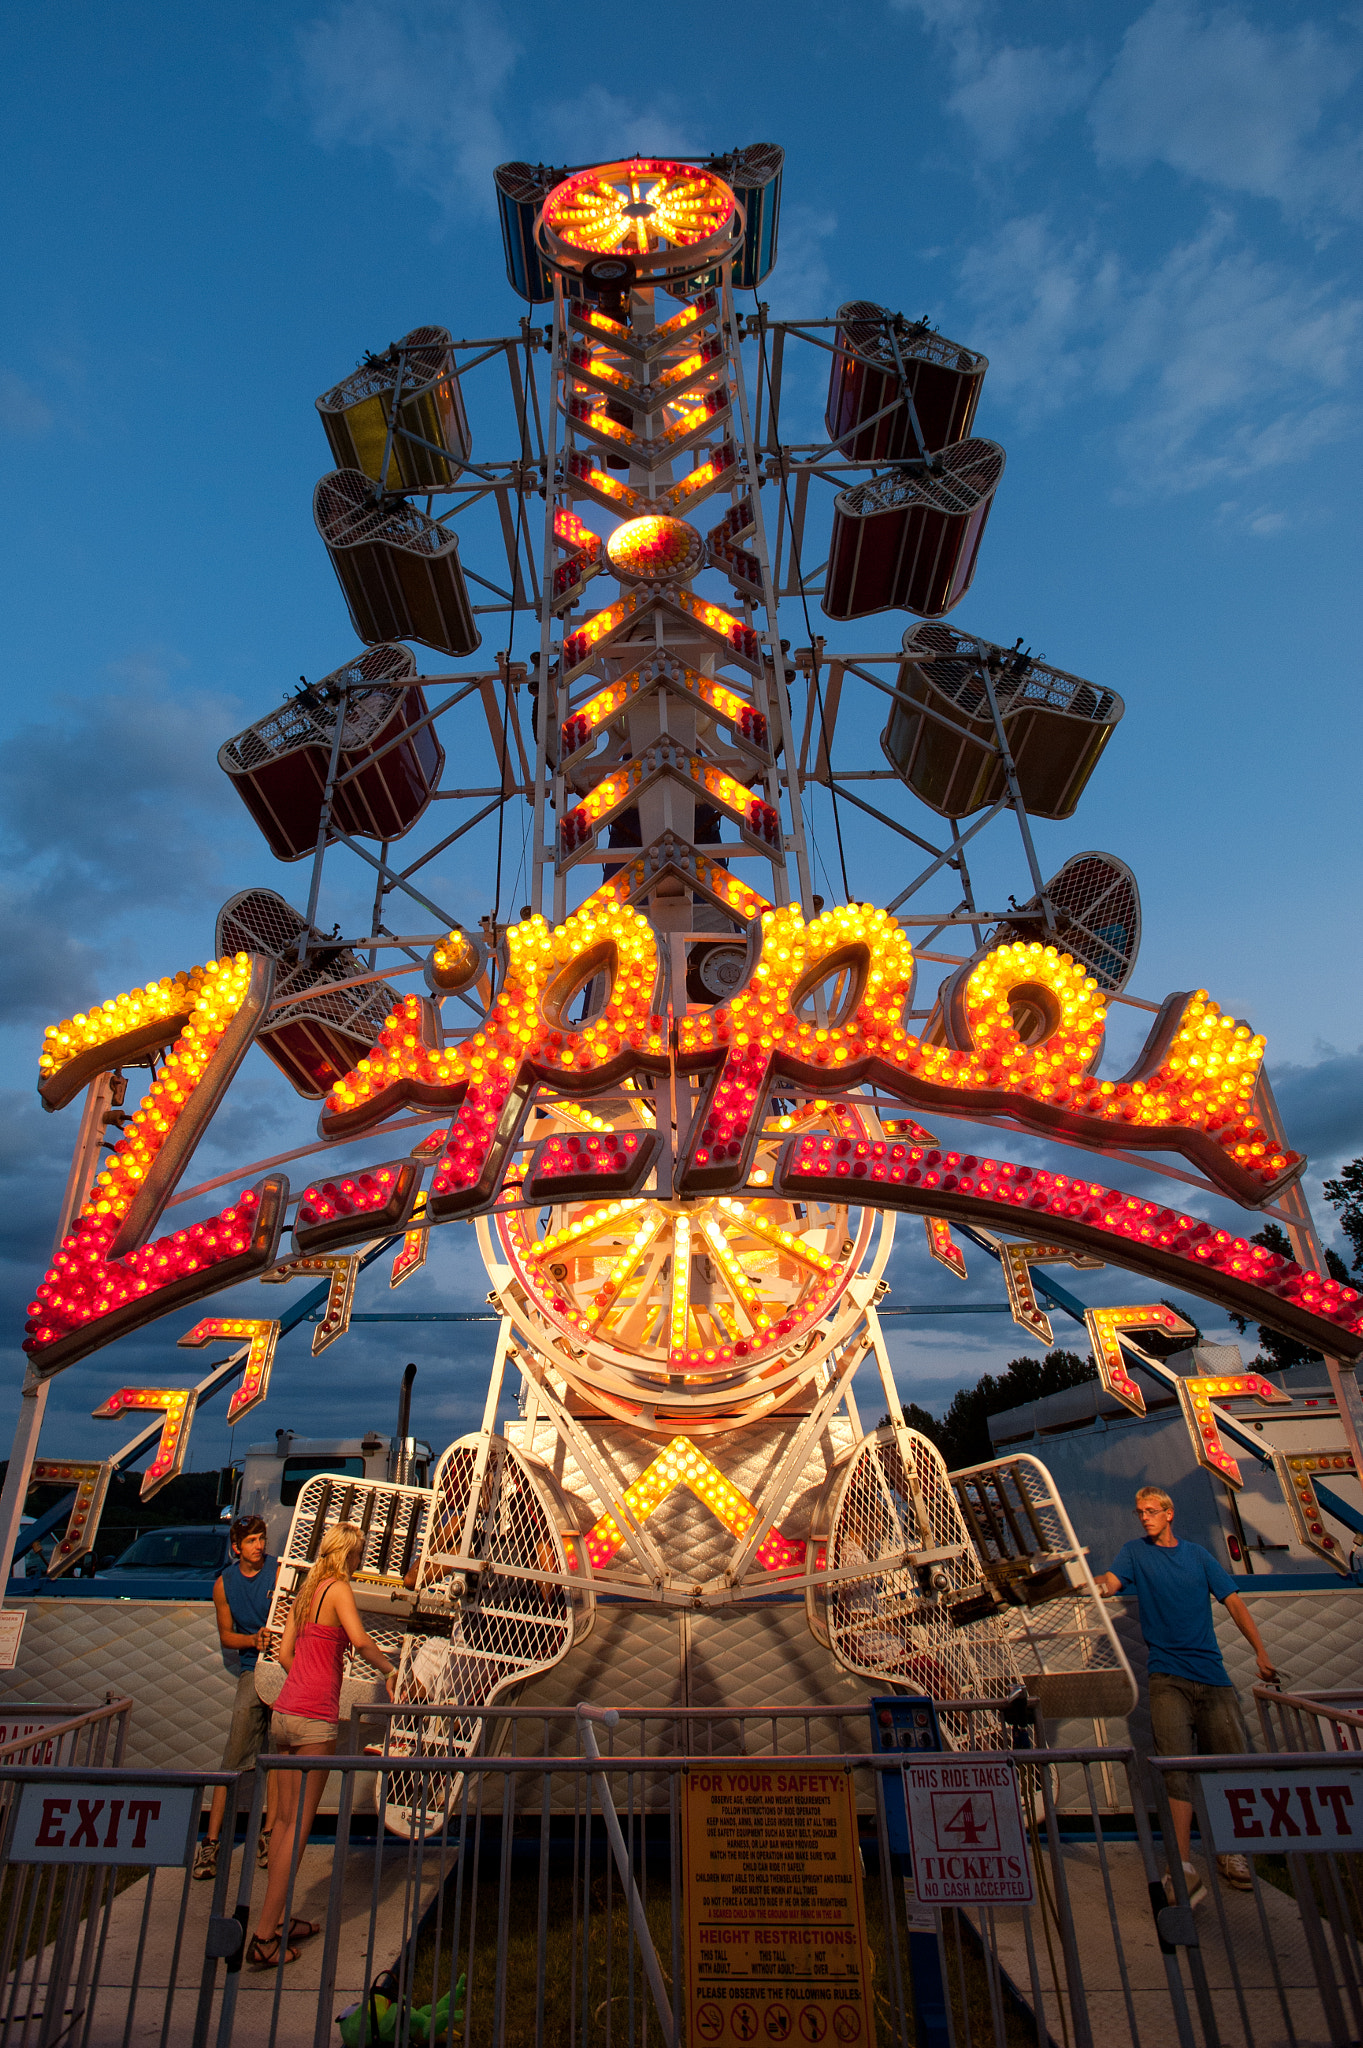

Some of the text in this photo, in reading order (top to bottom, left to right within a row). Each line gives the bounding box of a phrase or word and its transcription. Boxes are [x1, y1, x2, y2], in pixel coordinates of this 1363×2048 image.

[690, 1775, 845, 1793] FOR YOUR SAFETY:
[909, 1767, 1010, 1788] THIS RIDE TAKES
[944, 1797, 988, 1844] 4
[1224, 1785, 1354, 1838] EXIT
[34, 1798, 162, 1848] EXIT
[920, 1856, 1022, 1880] TICKETS
[924, 1883, 939, 1897] NO
[943, 1883, 971, 1896] CASH
[974, 1881, 1025, 1896] ACCEPTED
[700, 1930, 857, 1945] HEIGHT RESTRICTIONS:
[700, 1950, 826, 1962] THIS TALL THIS TALL NOT
[698, 1963, 860, 1975] WITH ADULT WITHOUT ADULT OVER TALL
[696, 1987, 862, 2000] PLEASE OBSERVE THE FOLLOWING RULES:
